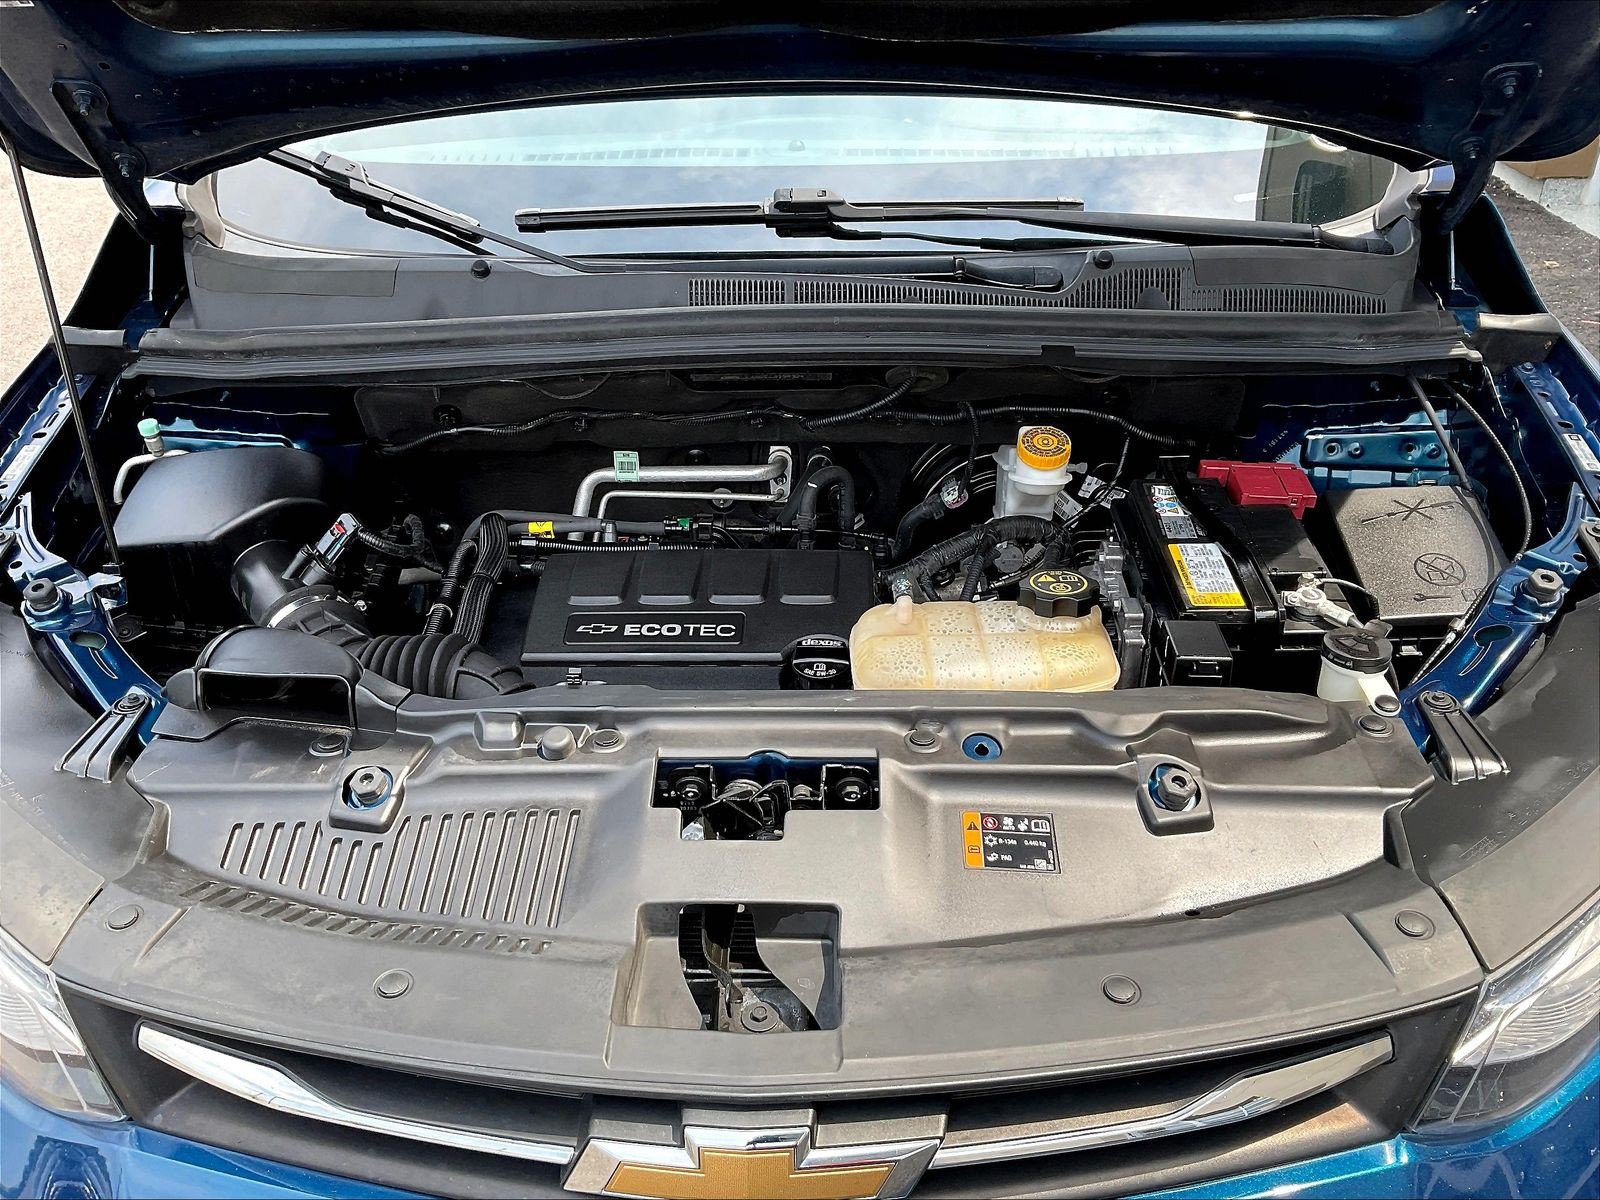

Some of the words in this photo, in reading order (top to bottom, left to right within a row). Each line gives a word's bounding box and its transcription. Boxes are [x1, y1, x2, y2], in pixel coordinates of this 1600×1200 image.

[623, 623, 736, 637] ECOTEC
[801, 638, 843, 646] dexos
[803, 668, 815, 676] SAE
